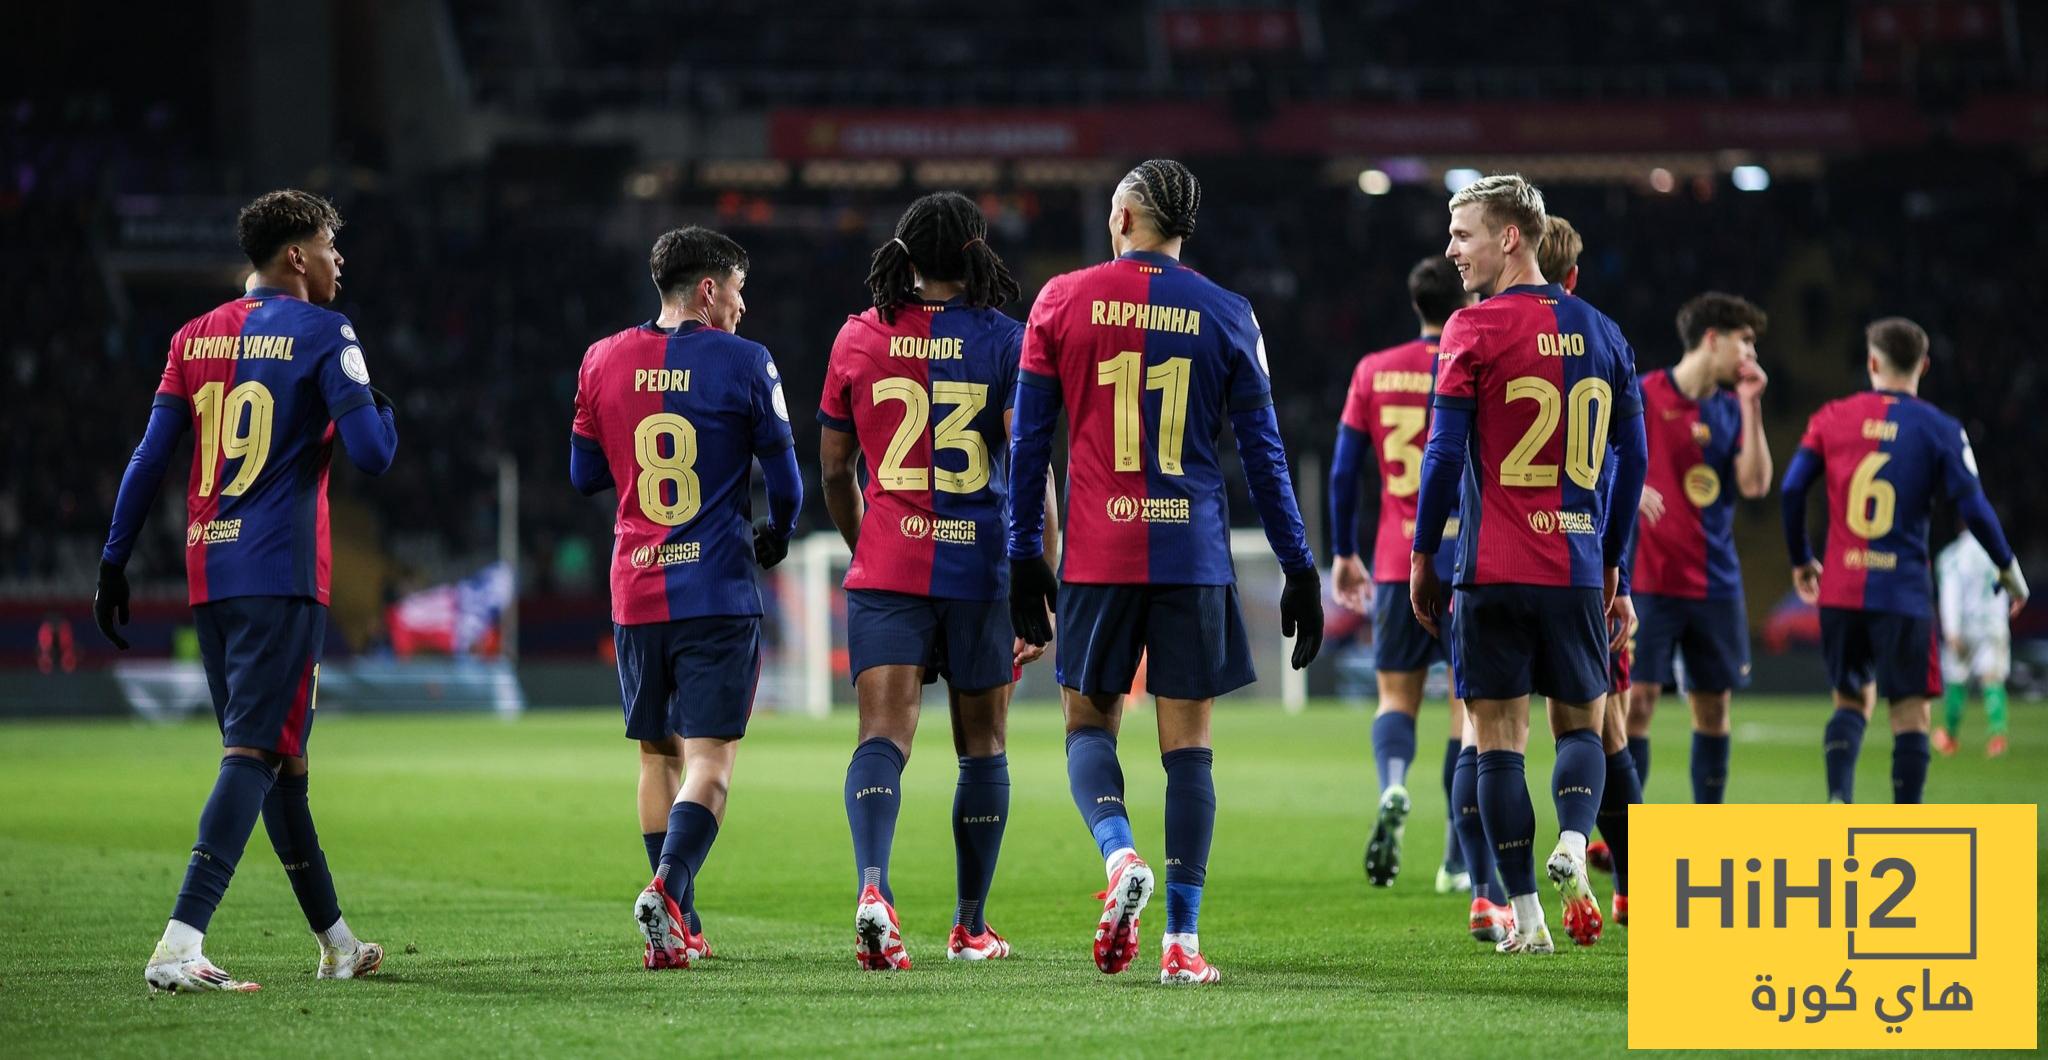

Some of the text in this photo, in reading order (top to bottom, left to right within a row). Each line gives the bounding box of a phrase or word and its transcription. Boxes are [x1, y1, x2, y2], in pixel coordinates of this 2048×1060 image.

[1091, 301, 1200, 336] RAPHINHA
[183, 335, 294, 360] LAMINE YAMAL
[889, 336, 963, 360] KOUNDE
[1537, 333, 1585, 357] OLMO
[635, 369, 690, 392] PEDRI
[1098, 351, 1192, 476] 11
[192, 380, 274, 497] 19
[872, 377, 990, 493] 23
[1499, 376, 1613, 490] 20
[634, 413, 701, 526] 8
[1141, 498, 1190, 509] UNHCR
[1846, 451, 1897, 539] 6
[932, 519, 976, 530] UNHCR
[1141, 507, 1190, 518] ACNUR
[203, 529, 240, 541] ACNUR
[932, 529, 976, 540] ACNUR
[657, 542, 701, 554] UNHCR
[657, 551, 700, 564] ACNUR
